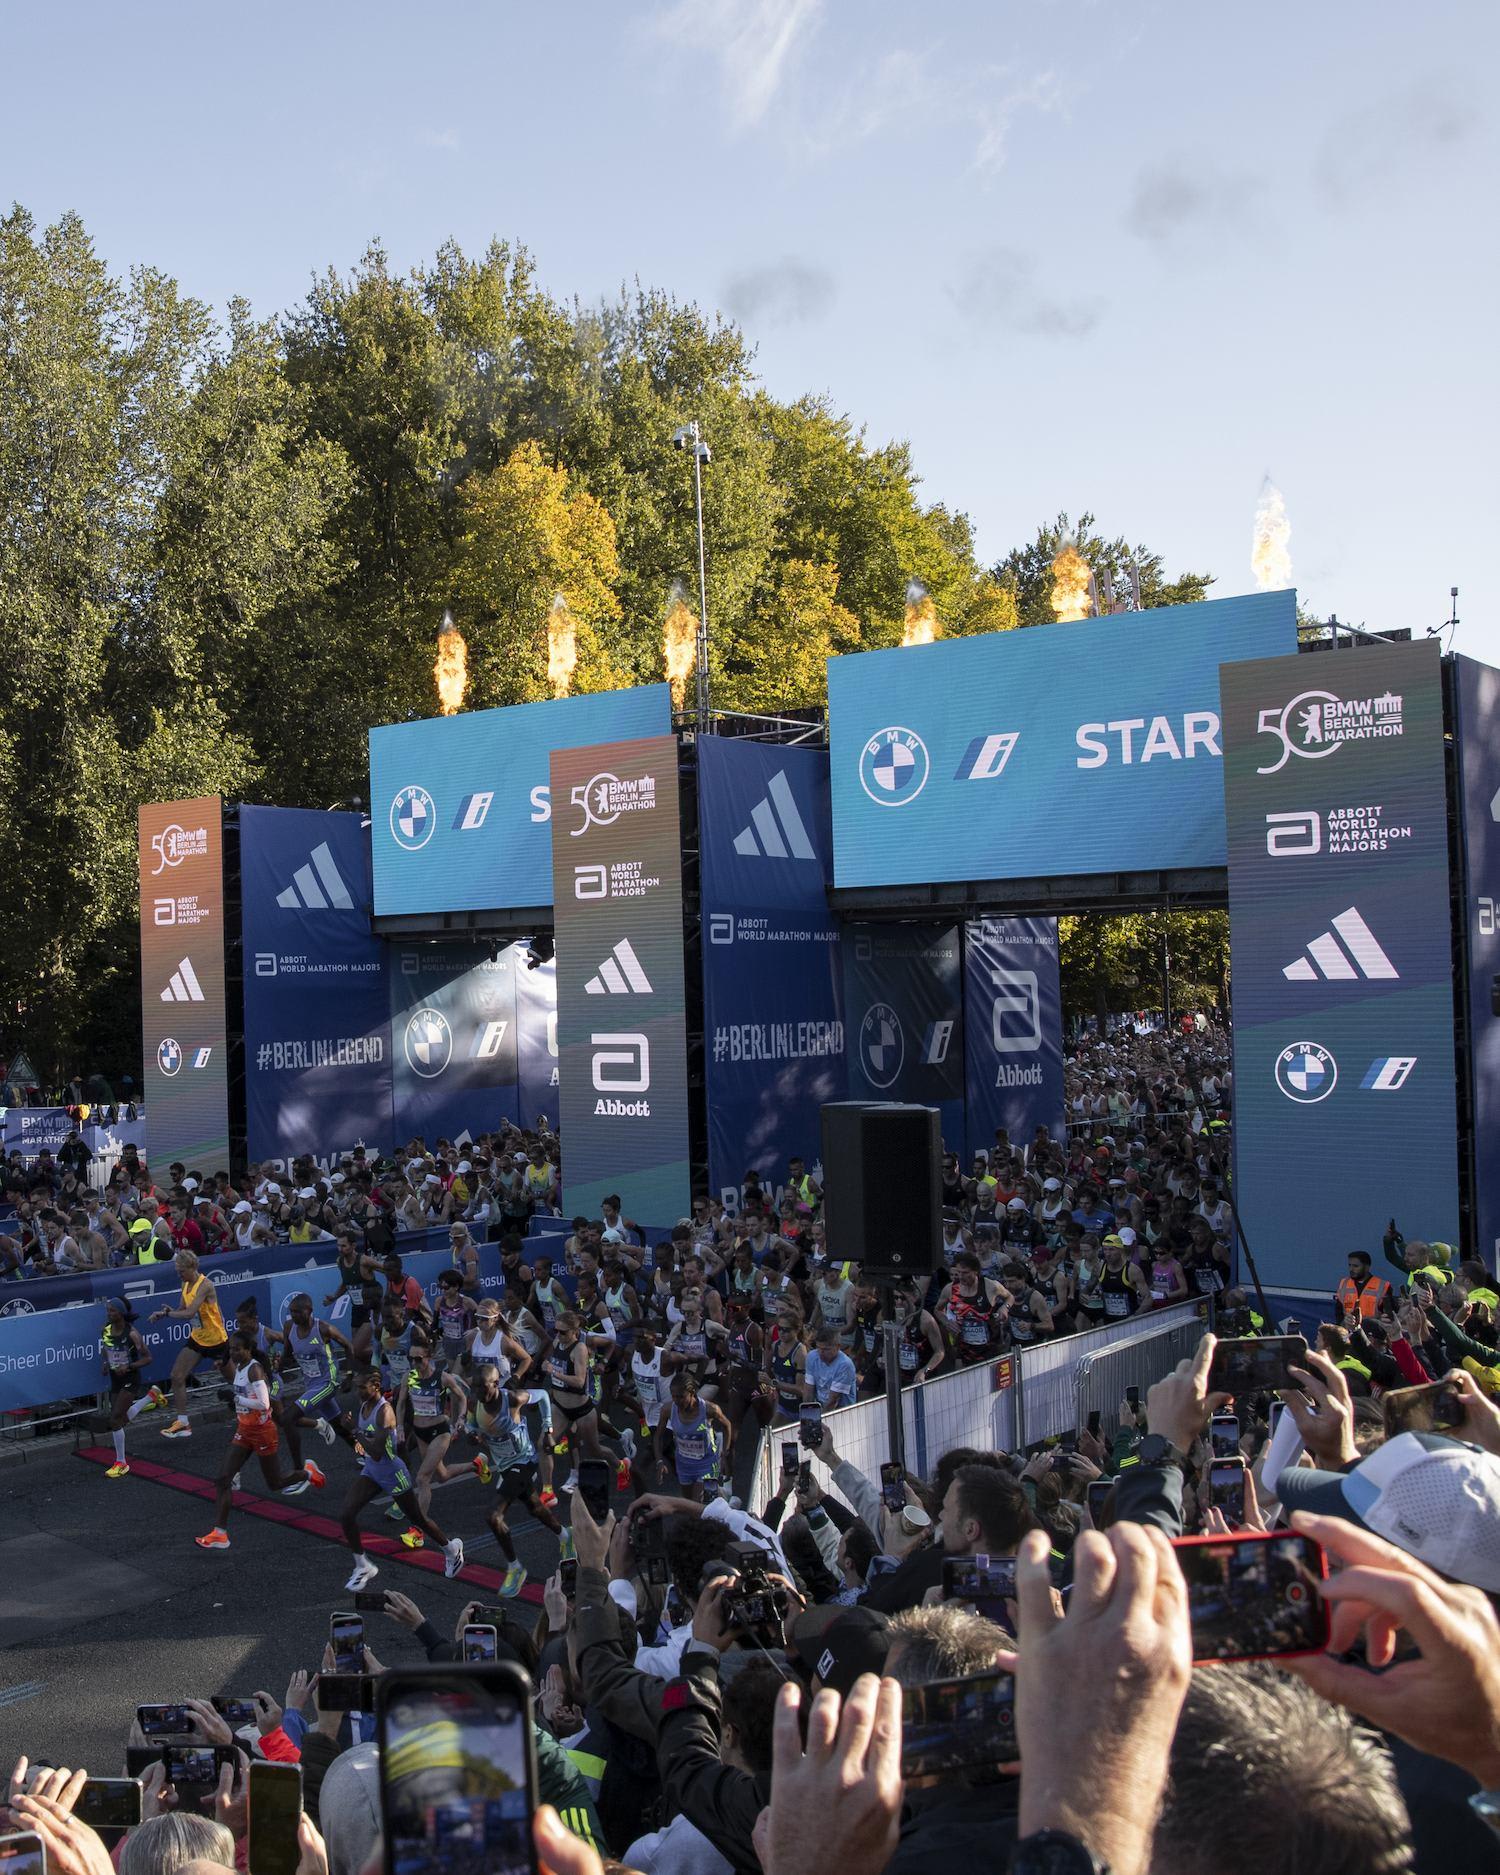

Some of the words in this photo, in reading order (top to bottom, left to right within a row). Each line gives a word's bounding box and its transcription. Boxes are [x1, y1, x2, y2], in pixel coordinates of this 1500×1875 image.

[1324, 698, 1372, 718] BMW
[1324, 715, 1373, 730] BERLIN
[1324, 724, 1403, 742] MARATHON
[868, 731, 919, 756] BMW
[609, 780, 638, 794] BMW
[396, 789, 429, 808] BMW
[609, 792, 638, 802] BERLIN
[610, 800, 656, 812] MARATHON
[1328, 806, 1382, 820] ABBOTT
[1328, 818, 1378, 830] WORLD
[176, 830, 196, 842] BMW
[1329, 827, 1411, 842] MARATHON
[177, 840, 196, 850] BERLIN
[178, 847, 207, 856] MARATHON
[1330, 840, 1387, 854] MAJORS
[610, 862, 642, 872] ABBOTT
[611, 871, 640, 880] WORLD
[611, 878, 660, 888] MARATHON
[612, 888, 646, 897] MAJORS
[178, 909, 209, 917] MARATHON
[738, 919, 768, 928] ABBOTT
[738, 930, 765, 940] WORLD
[767, 932, 811, 941] MARATHON
[411, 1012, 446, 1032] BMW
[866, 1007, 898, 1031] BMW
[712, 1020, 844, 1062] #BERLINLEGEND
[256, 1036, 384, 1070] #BERLINLEGEND
[1283, 1044, 1328, 1062] BMW
[995, 1062, 1043, 1088] Abbott
[594, 1098, 650, 1116] Abbott
[22, 1116, 54, 1129] BMW
[22, 1128, 55, 1136] BERLIN
[22, 1135, 67, 1144] MARATHO
[2, 1301, 31, 1315] BMW
[0, 1354, 40, 1373] Sheer
[45, 1343, 94, 1365] Driving
